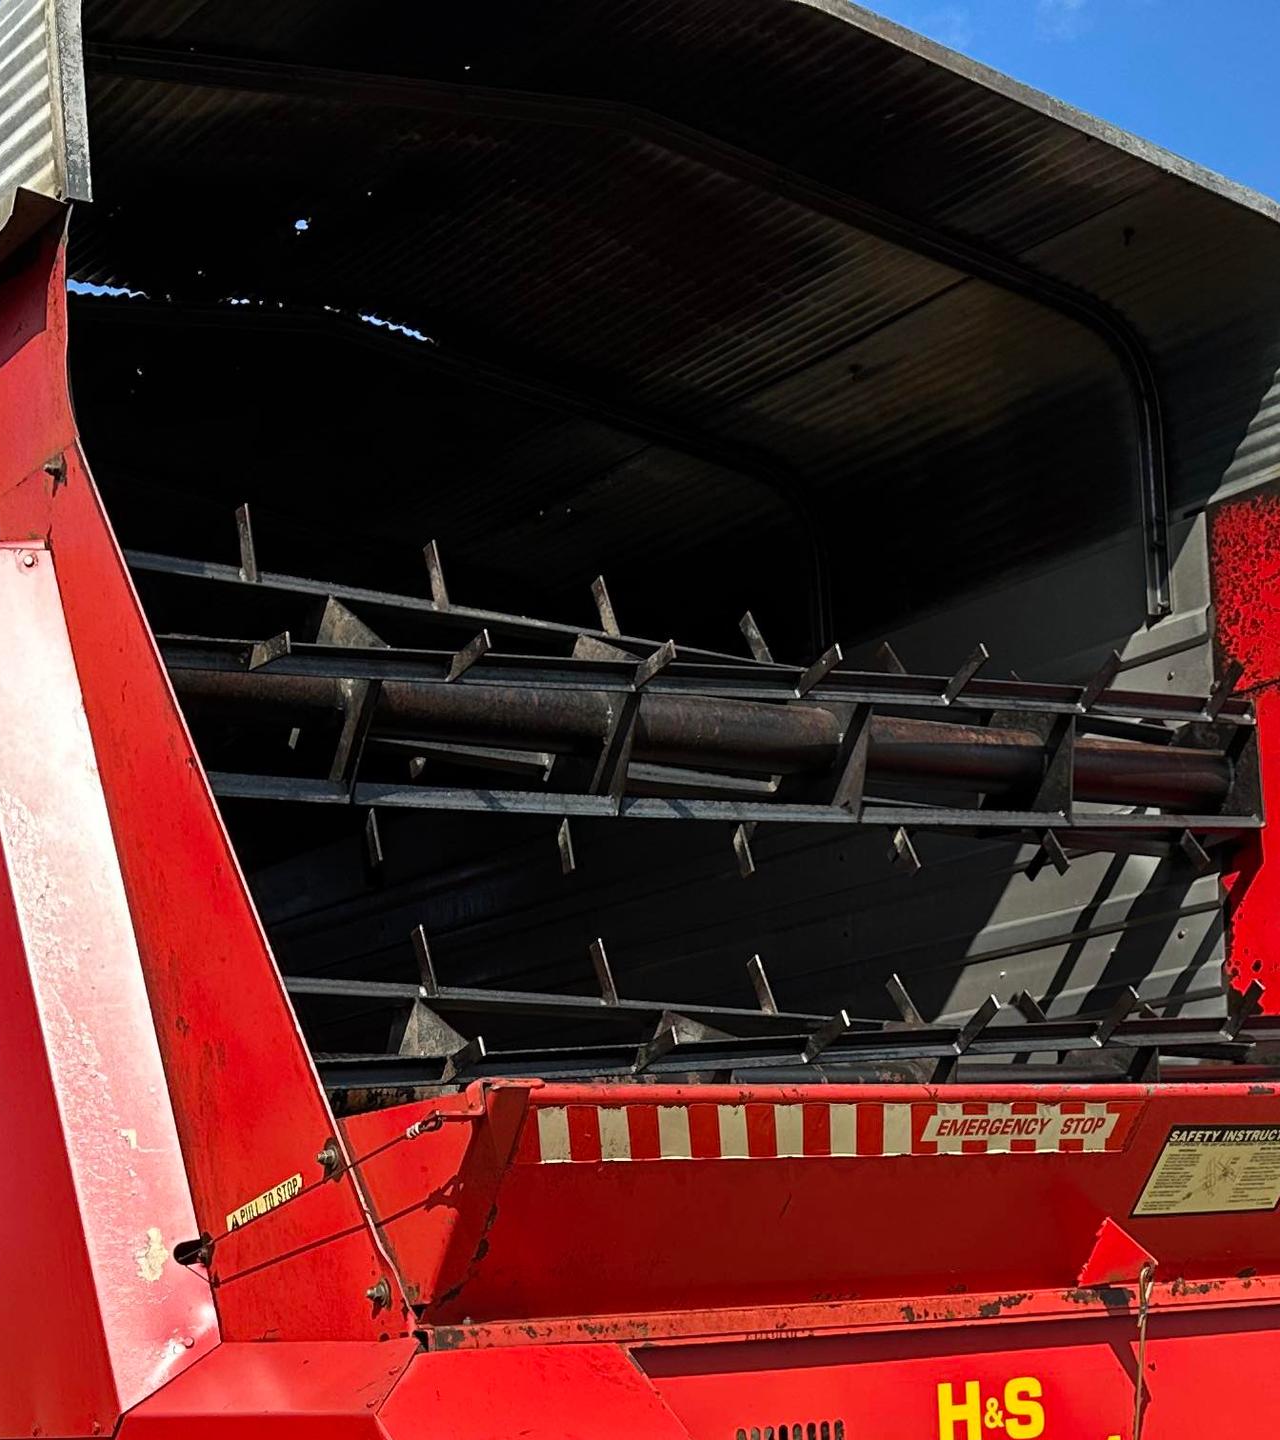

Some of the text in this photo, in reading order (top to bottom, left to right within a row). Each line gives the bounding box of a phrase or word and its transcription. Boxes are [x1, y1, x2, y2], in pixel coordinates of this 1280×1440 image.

[935, 1113, 1107, 1138] EMERGENCY STOP
[1169, 1130, 1221, 1142] SAFETY
[263, 1192, 275, 1211] TO
